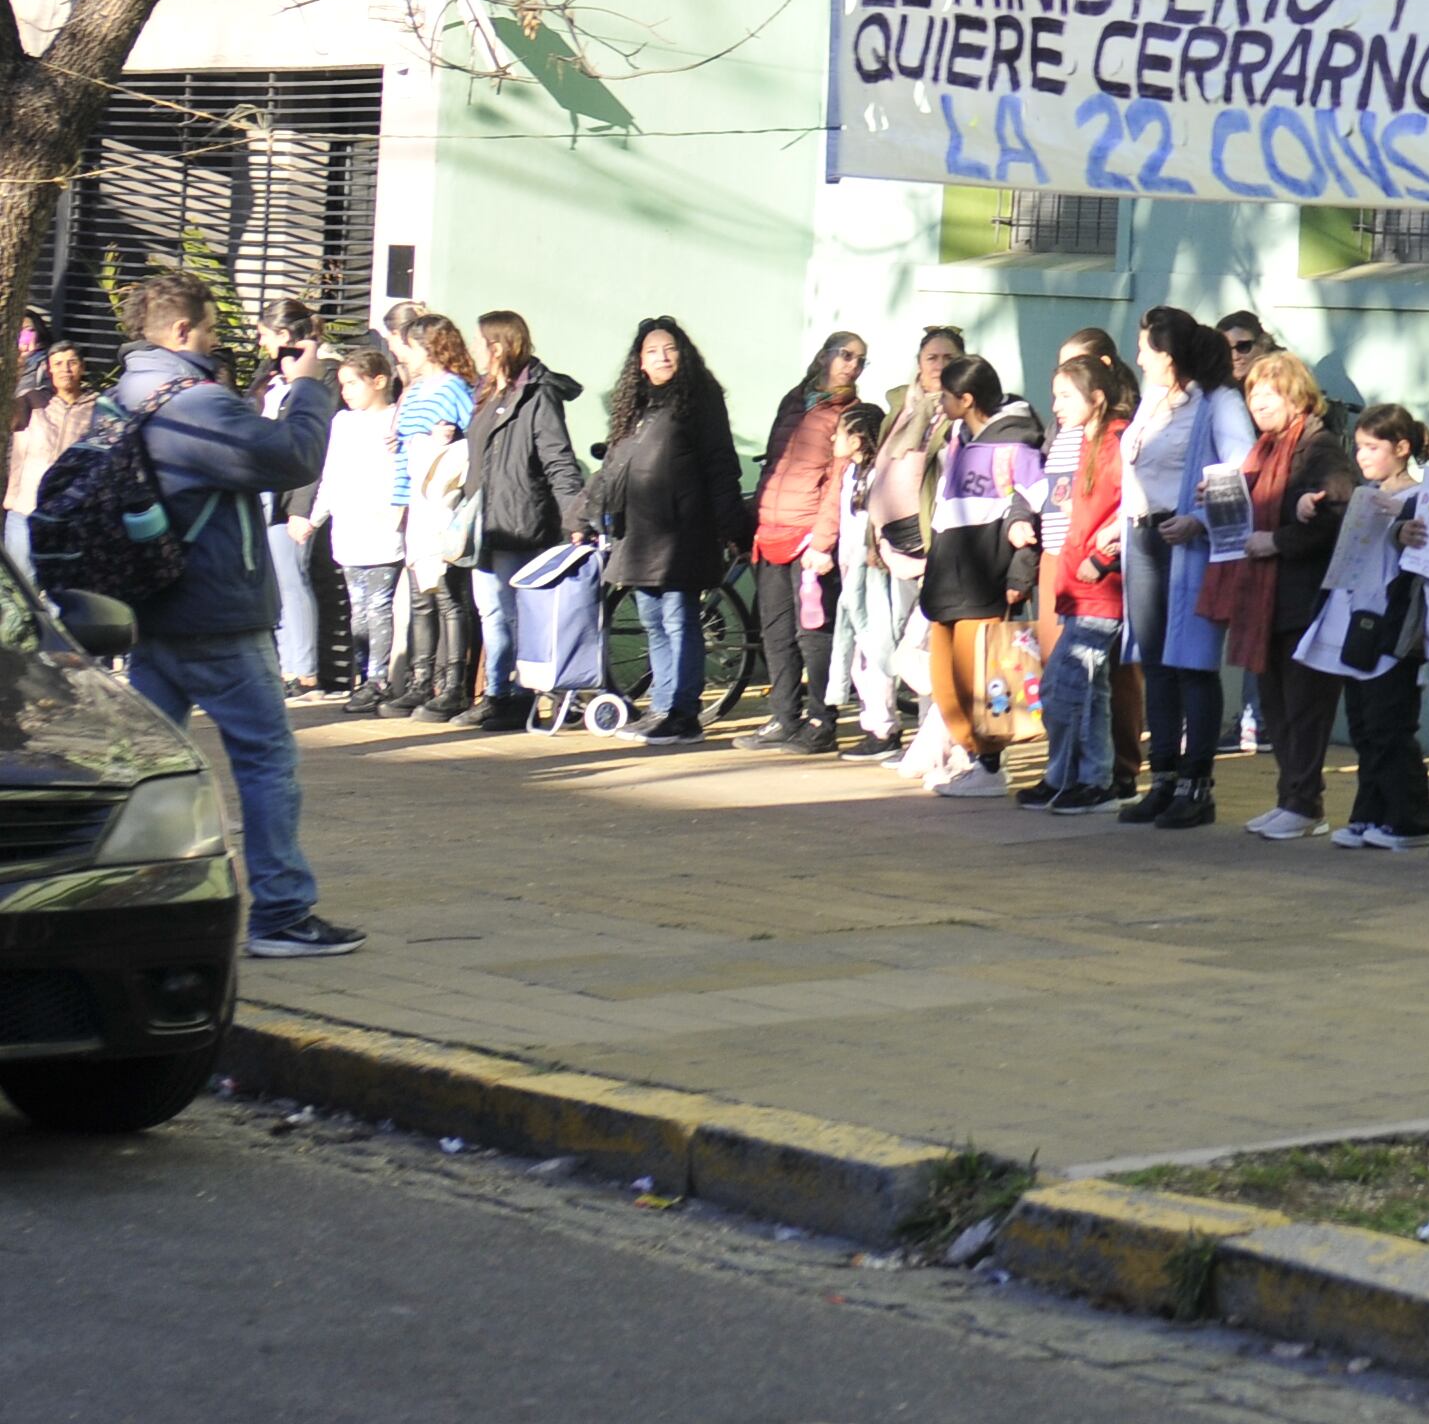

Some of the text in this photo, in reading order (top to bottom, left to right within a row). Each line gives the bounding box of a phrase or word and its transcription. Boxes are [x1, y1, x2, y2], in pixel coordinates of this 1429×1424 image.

[853, 10, 1069, 95] QUIERE
[940, 92, 1048, 186] LA
[1074, 95, 1196, 198] 22
[962, 470, 993, 497] 25
